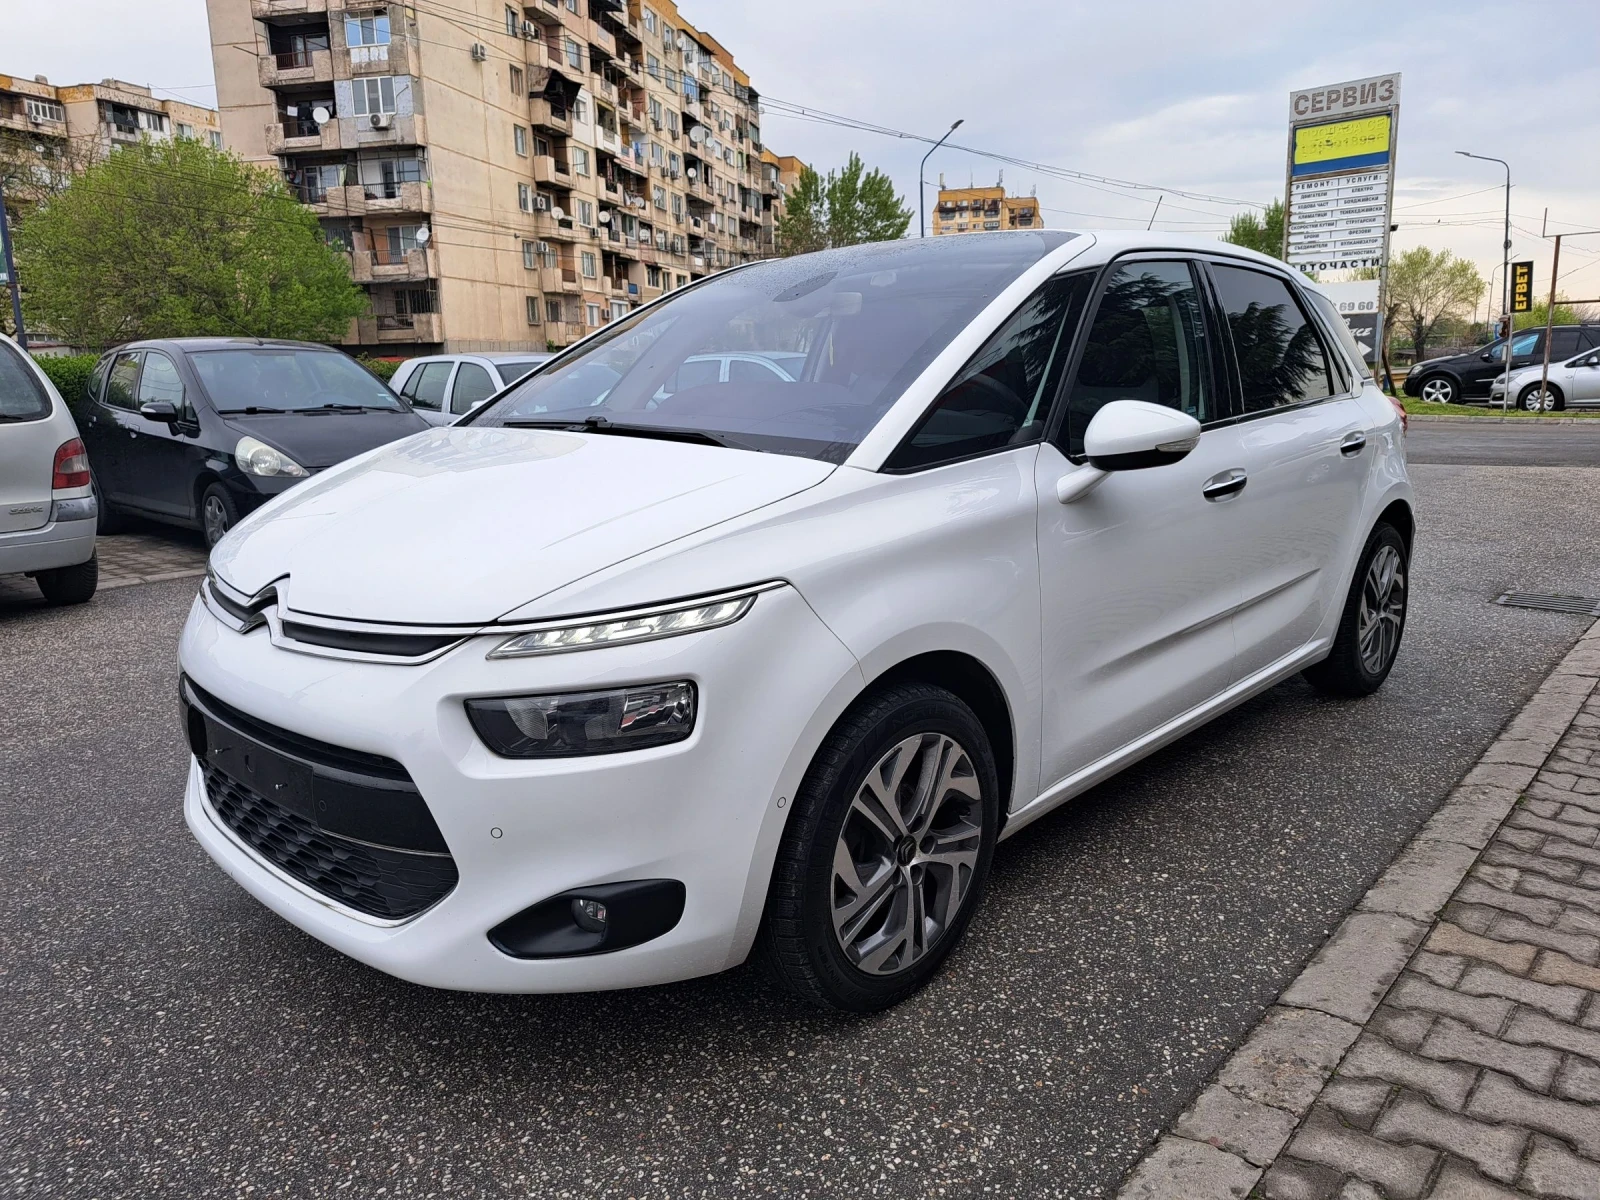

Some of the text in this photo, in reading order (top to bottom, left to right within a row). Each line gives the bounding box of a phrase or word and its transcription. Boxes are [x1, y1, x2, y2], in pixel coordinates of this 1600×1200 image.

[1294, 79, 1394, 115] СЕРВИЗ
[1346, 174, 1382, 184] УСЛУГИ:
[1296, 181, 1334, 190] РЕМОНТ:
[1515, 265, 1528, 310] EFBET
[1339, 302, 1355, 311] 69
[1358, 301, 1374, 310] 60
